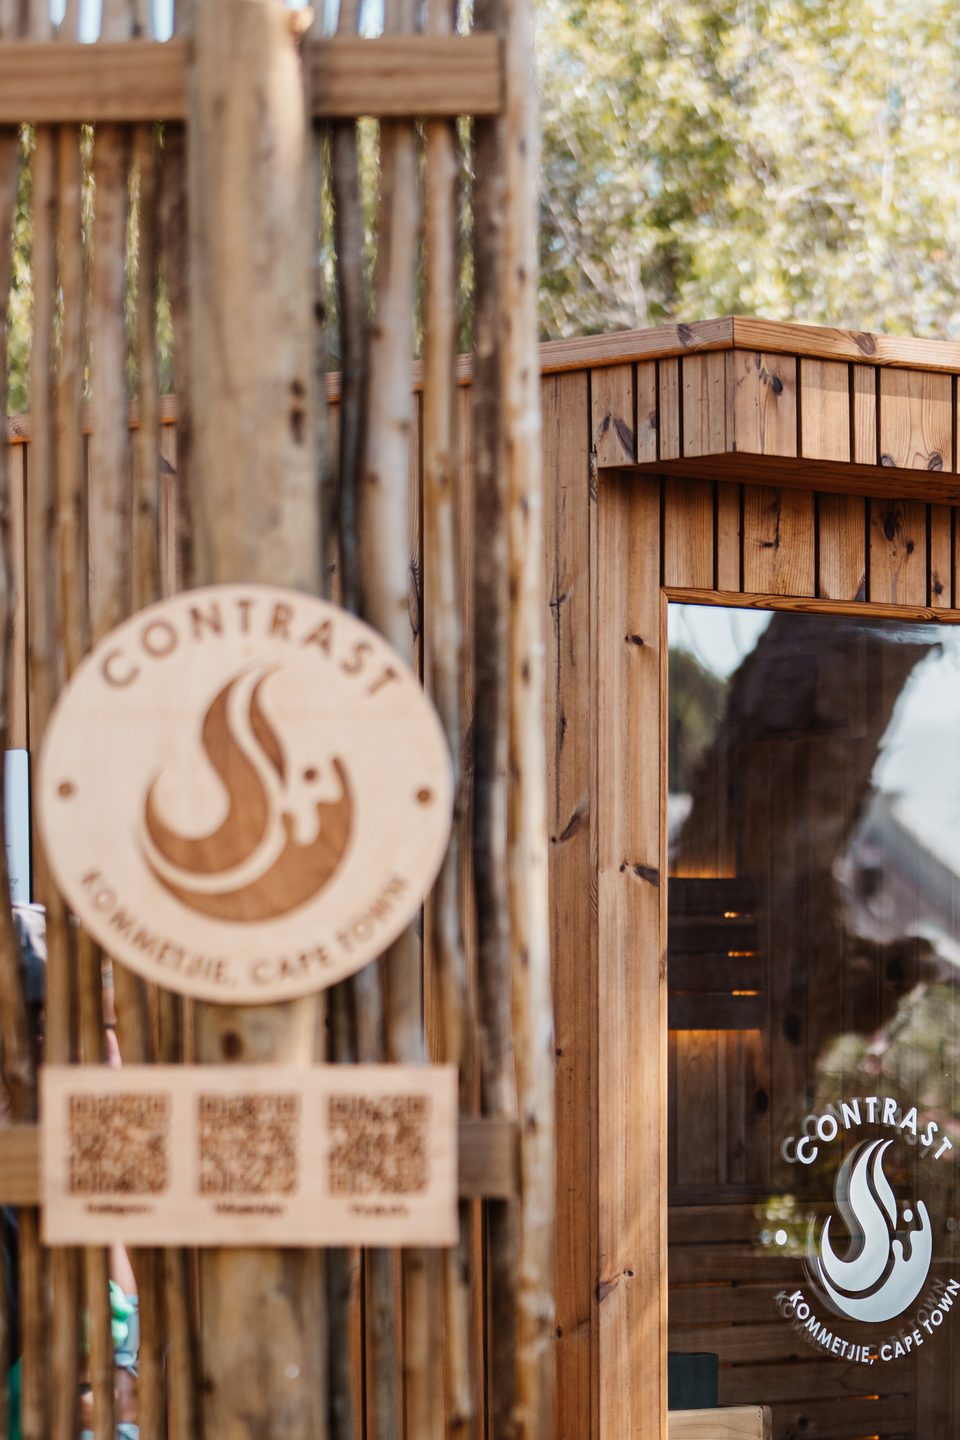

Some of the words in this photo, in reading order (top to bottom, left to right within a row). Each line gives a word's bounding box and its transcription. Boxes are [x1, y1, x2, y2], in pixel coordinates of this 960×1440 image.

[100, 598, 402, 697] CONTRAST
[249, 945, 336, 987] CAPE
[336, 874, 408, 949] TOWN
[796, 1096, 953, 1165] CONTRAST
[880, 1328, 924, 1362] CAPE
[922, 1278, 960, 1335] TOWN
